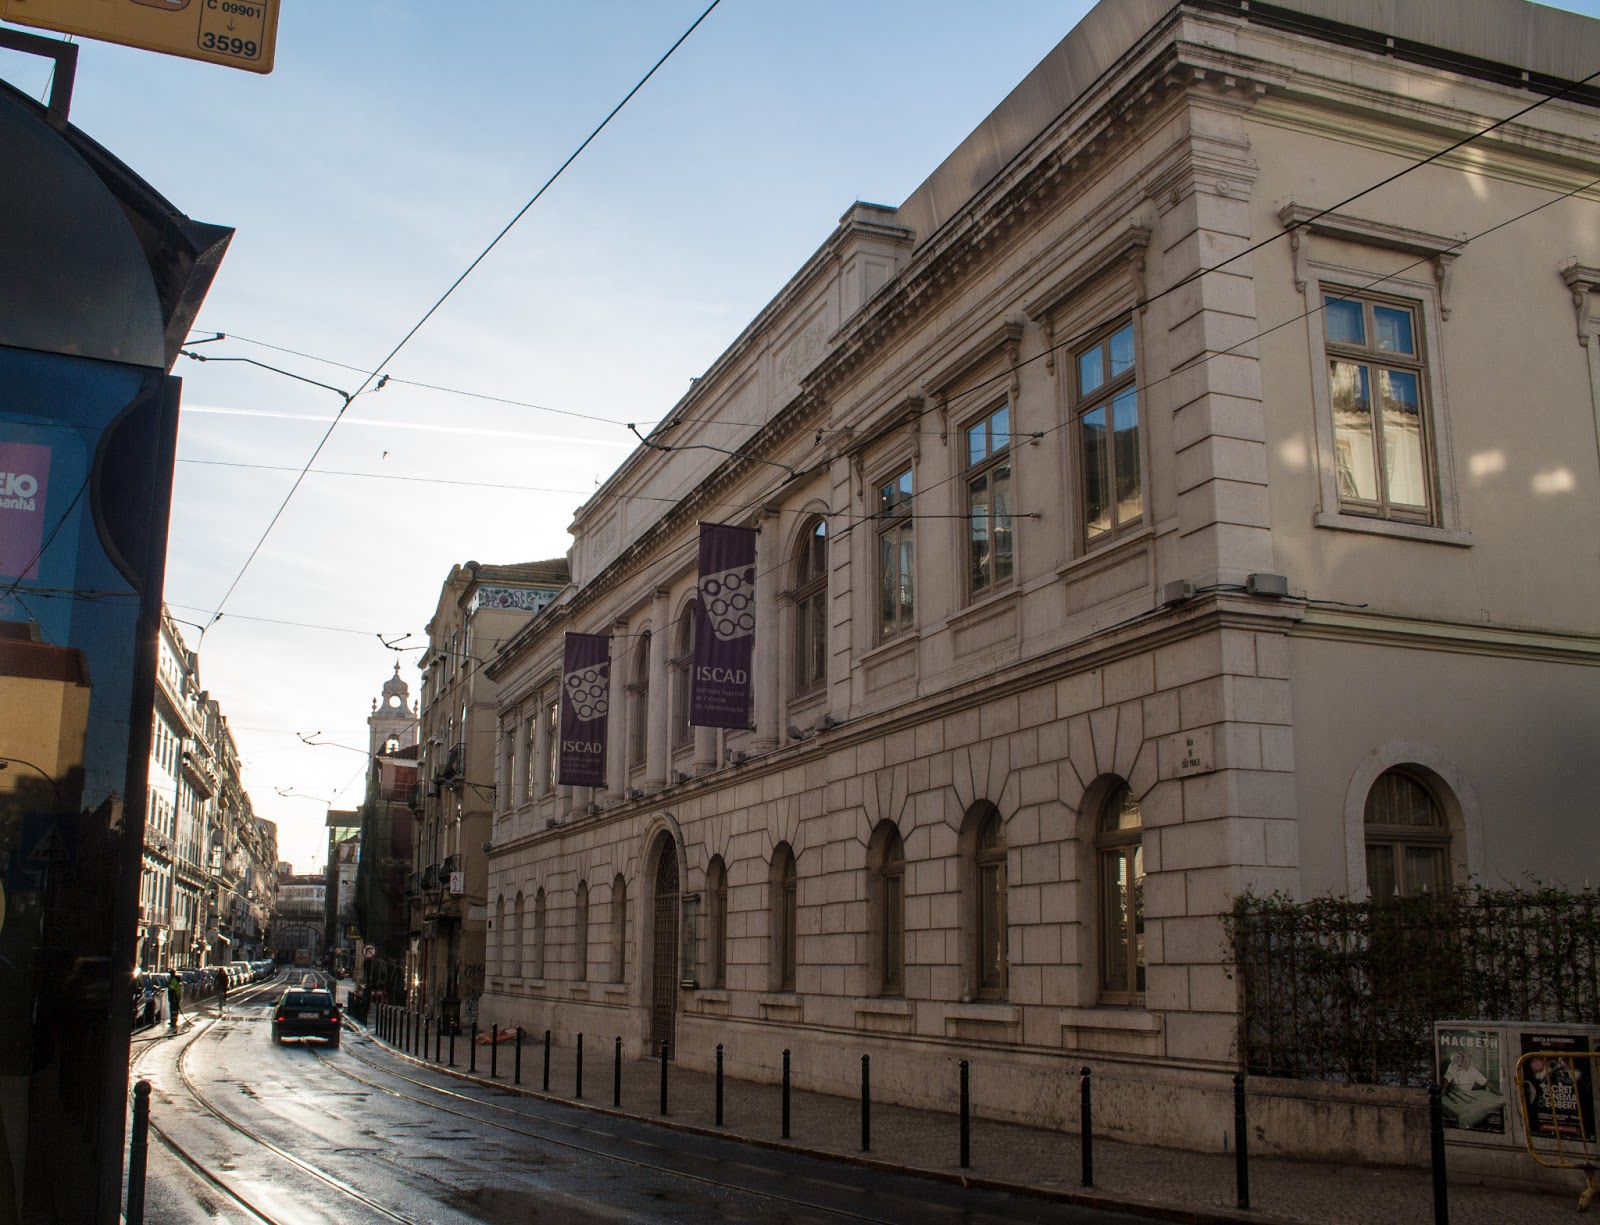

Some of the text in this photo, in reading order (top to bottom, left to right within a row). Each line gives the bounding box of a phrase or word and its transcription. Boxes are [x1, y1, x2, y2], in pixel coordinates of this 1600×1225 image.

[207, 0, 261, 18] C 09901
[202, 32, 257, 57] 3599
[0, 497, 35, 512] anhã
[697, 665, 747, 685] ISCAD
[563, 740, 602, 754] ISCAD
[1440, 1035, 1498, 1049] MACBETH
[1542, 1084, 1573, 1094] SCRET
[1543, 1092, 1577, 1102] CNEMA
